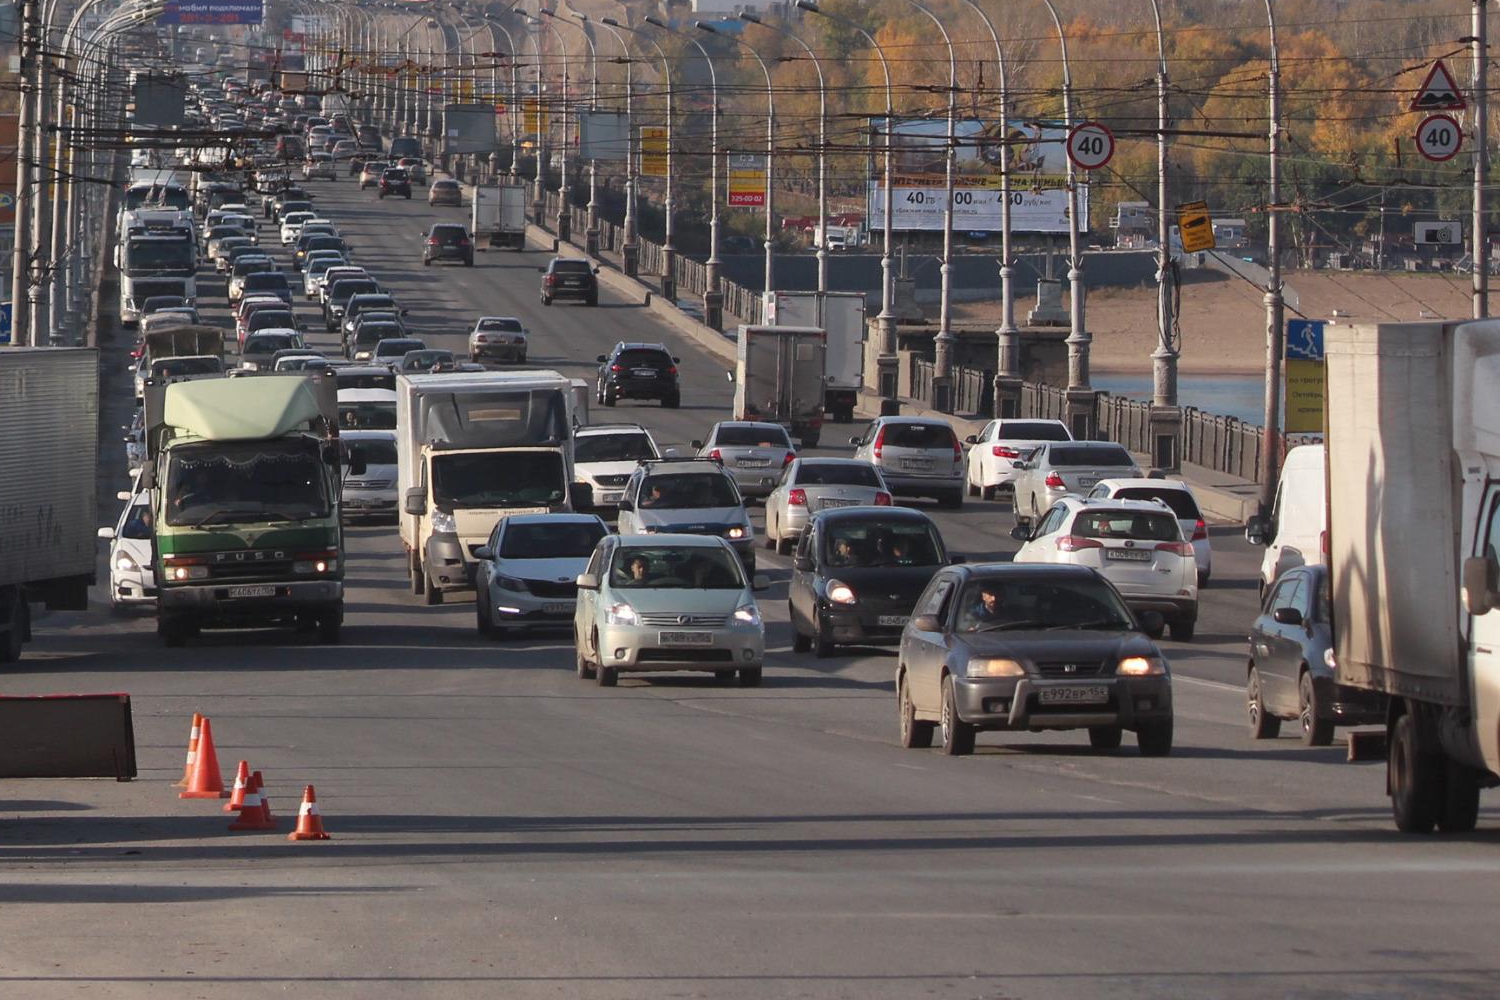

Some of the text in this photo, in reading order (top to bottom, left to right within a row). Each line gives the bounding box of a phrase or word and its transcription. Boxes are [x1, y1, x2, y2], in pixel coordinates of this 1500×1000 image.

[1077, 135, 1103, 155] 40
[1426, 128, 1451, 147] 40
[889, 177, 943, 187] НТЕРНЕТА
[906, 191, 924, 205] 40
[953, 191, 972, 206] 00
[216, 551, 284, 562] FUSO
